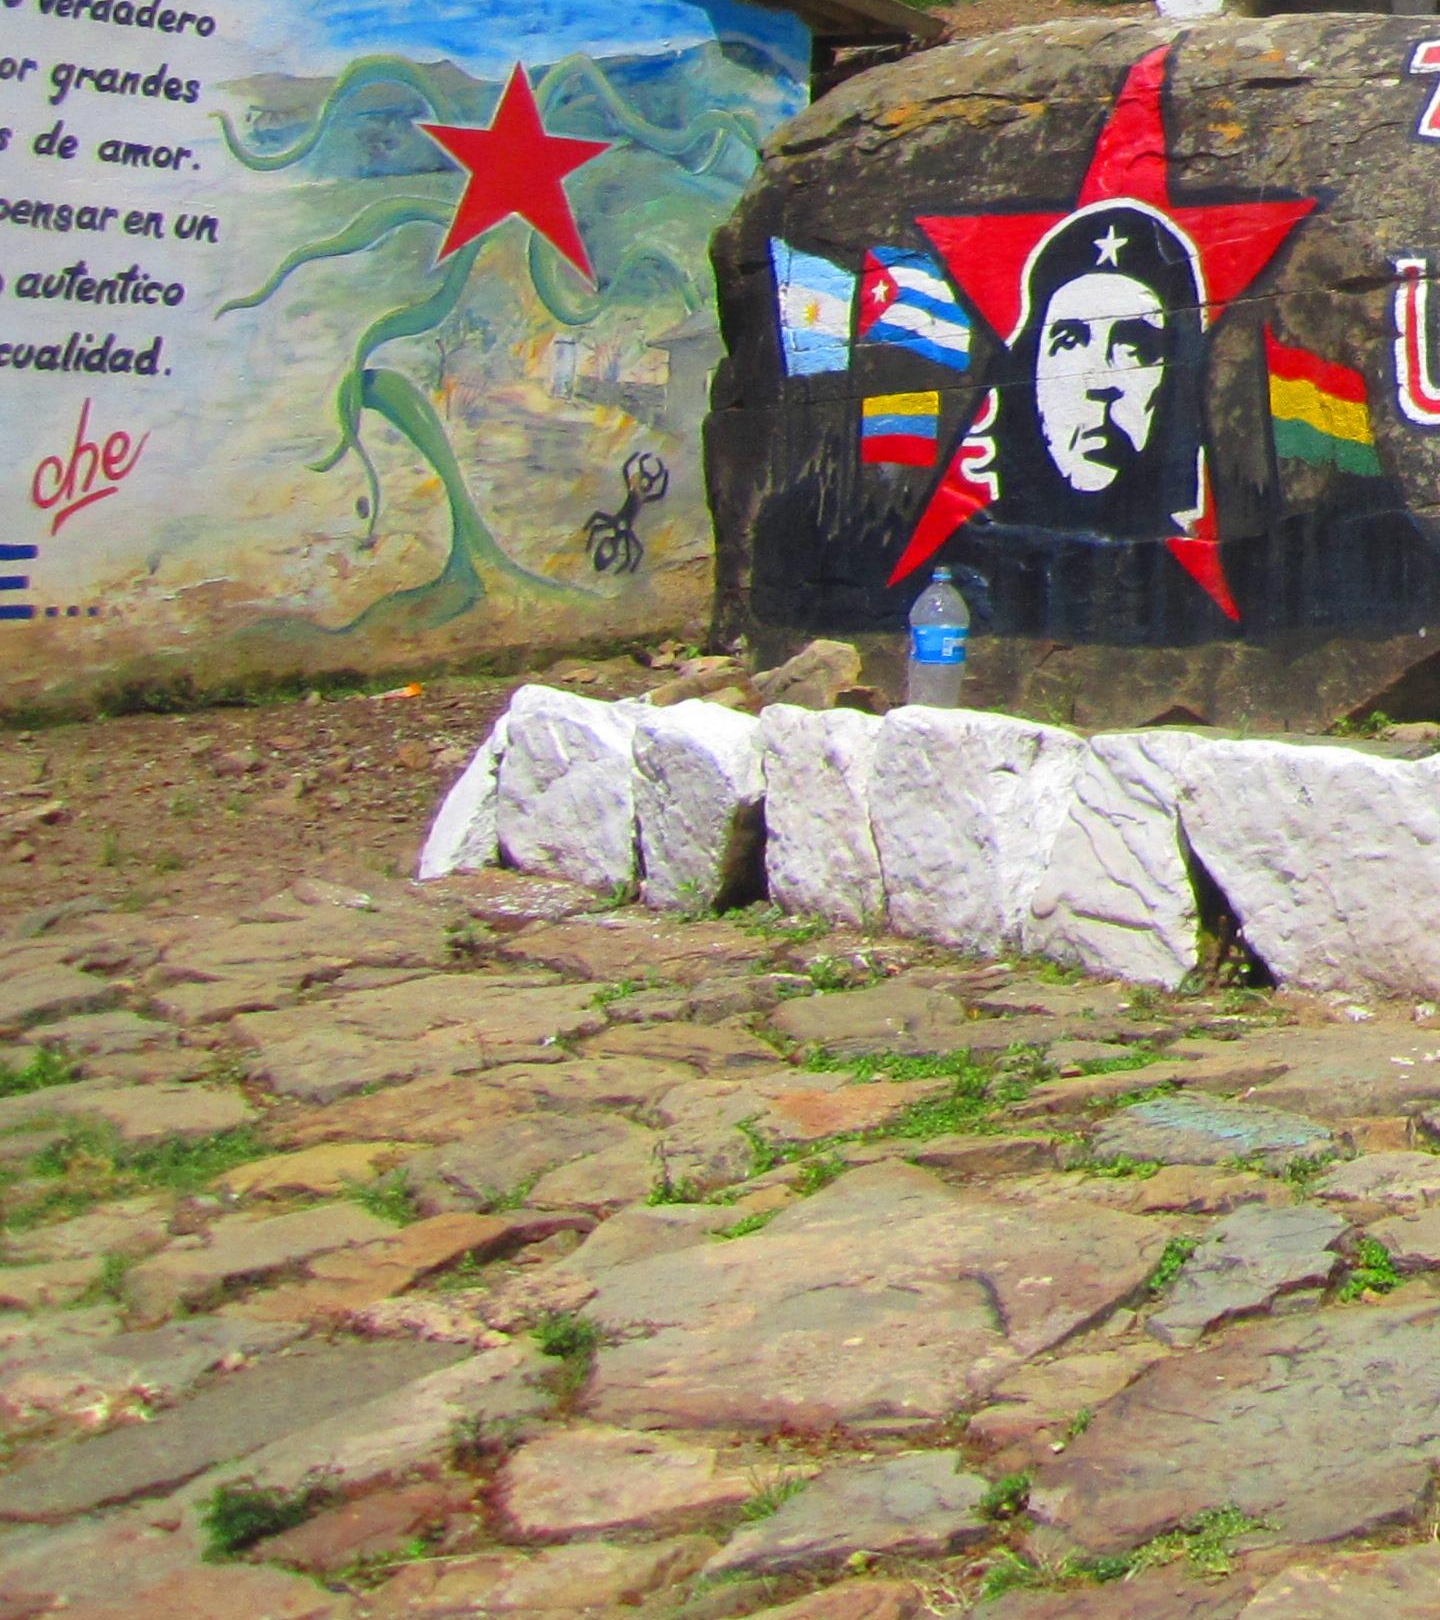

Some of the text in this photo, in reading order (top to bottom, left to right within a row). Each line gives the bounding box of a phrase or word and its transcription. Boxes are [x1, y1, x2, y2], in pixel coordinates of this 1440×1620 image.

[49, 63, 201, 105] grandes
[33, 120, 79, 160] de
[98, 139, 200, 171] amor.
[124, 210, 165, 239] en
[174, 213, 220, 243] un
[15, 260, 186, 306] autentico
